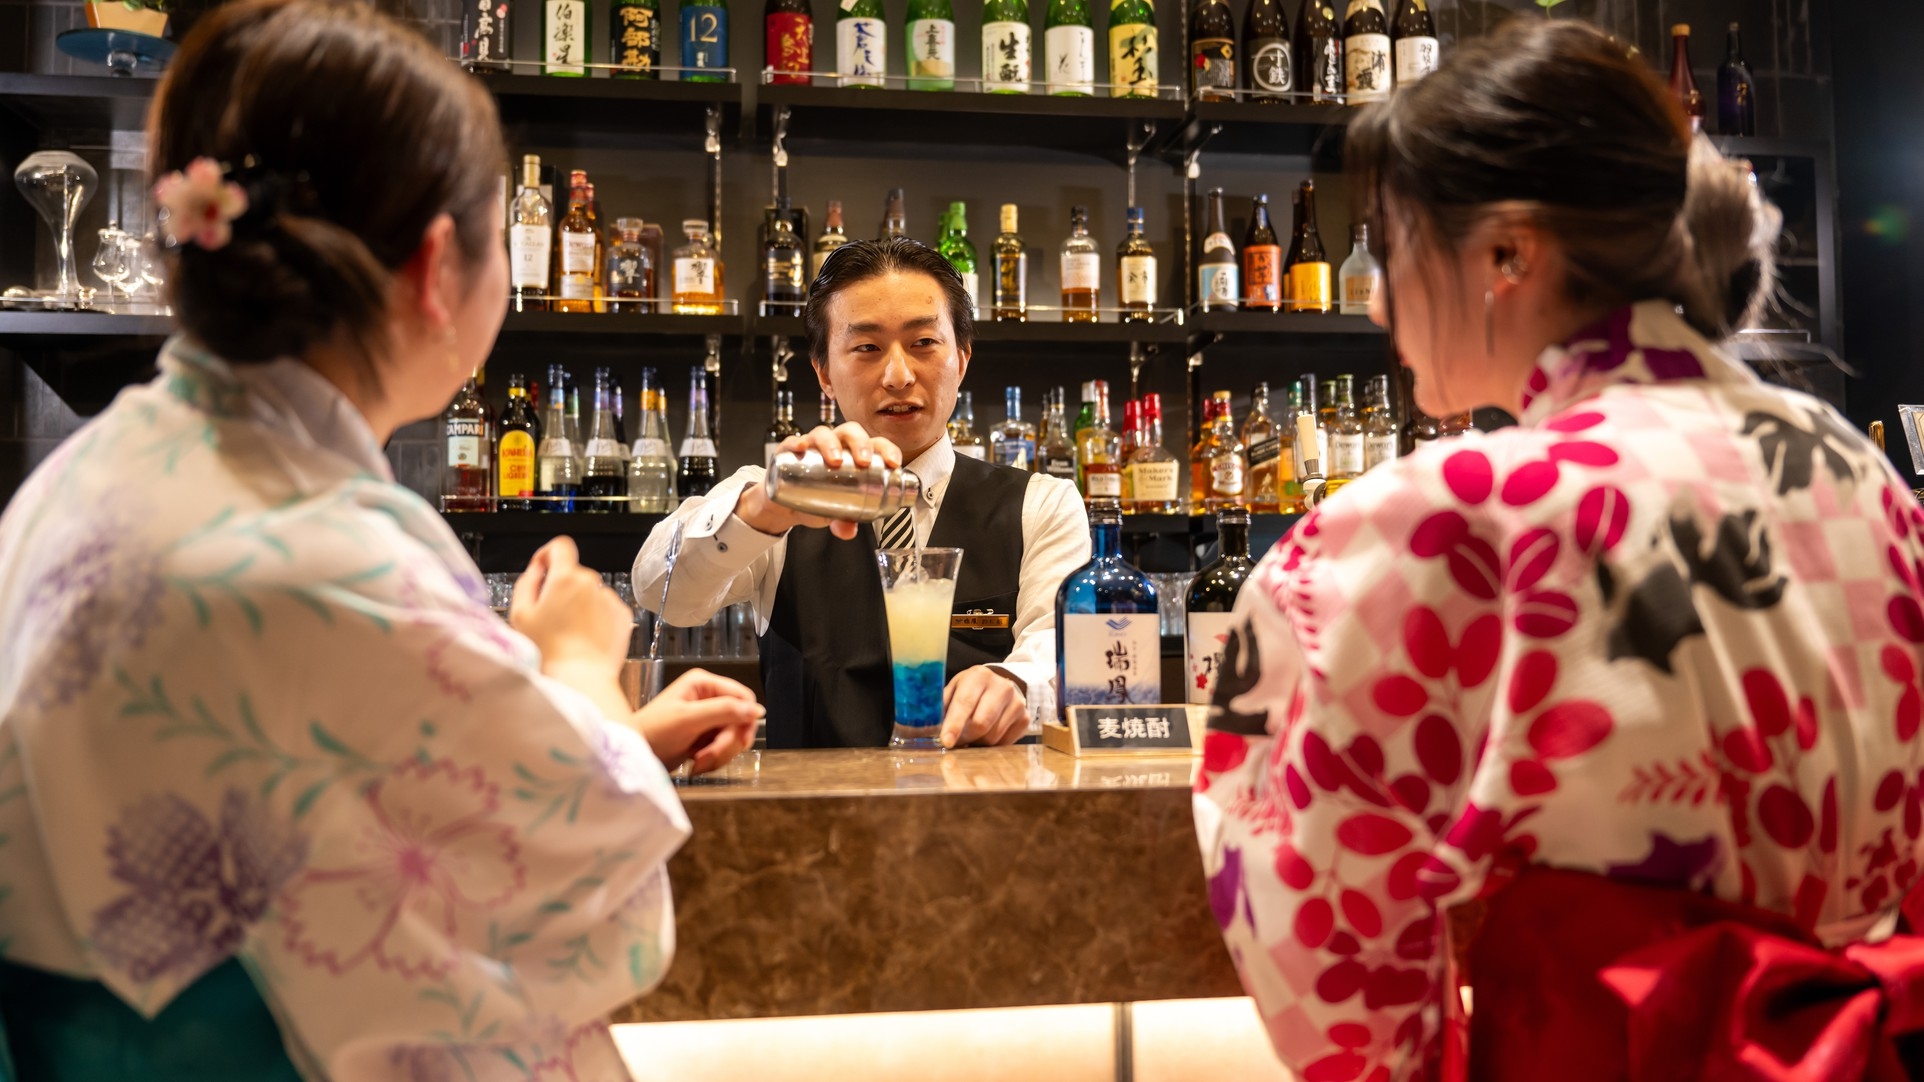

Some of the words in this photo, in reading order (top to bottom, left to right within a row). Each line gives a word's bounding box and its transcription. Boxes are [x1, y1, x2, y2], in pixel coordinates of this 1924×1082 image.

[690, 12, 718, 42] 12
[446, 422, 484, 436] CAMPARI
[1097, 716, 1170, 740] 麦焼酎
